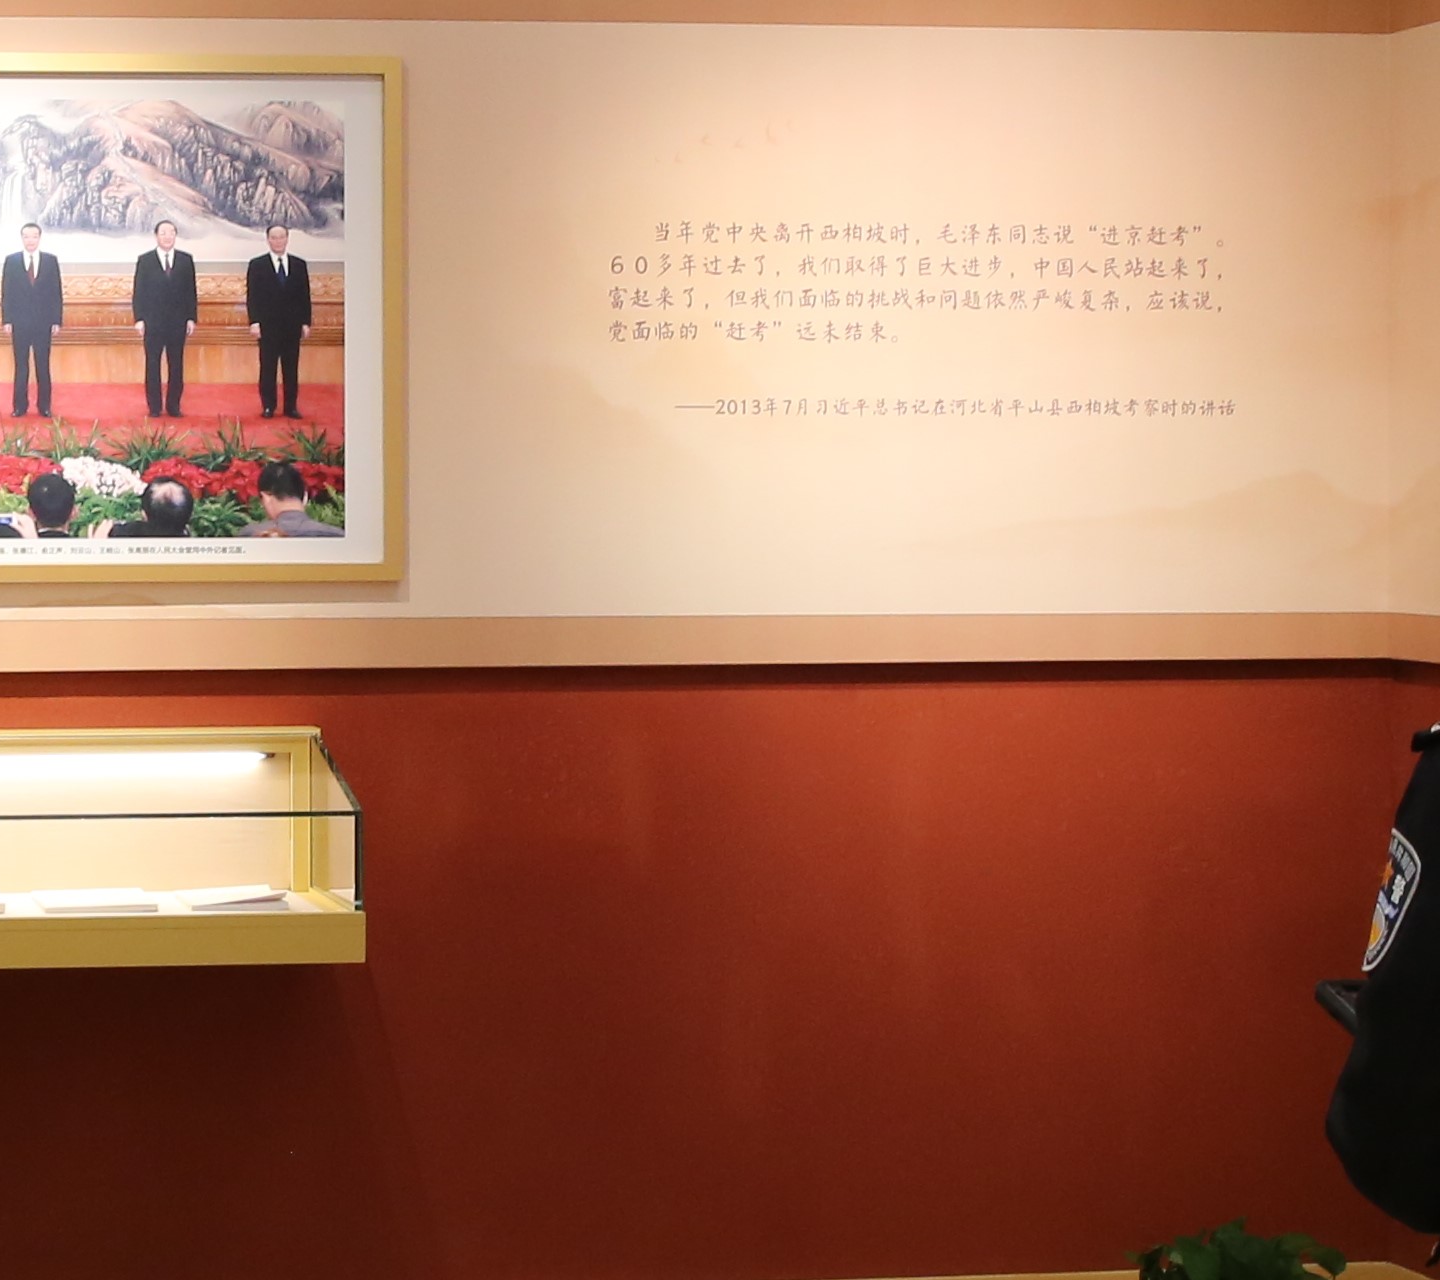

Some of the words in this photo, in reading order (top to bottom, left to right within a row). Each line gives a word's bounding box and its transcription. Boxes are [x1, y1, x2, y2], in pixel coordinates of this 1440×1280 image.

[607, 285, 1223, 313] 富起来了，但我们面临的挑战和问题依然严峻复杂，应该说，
